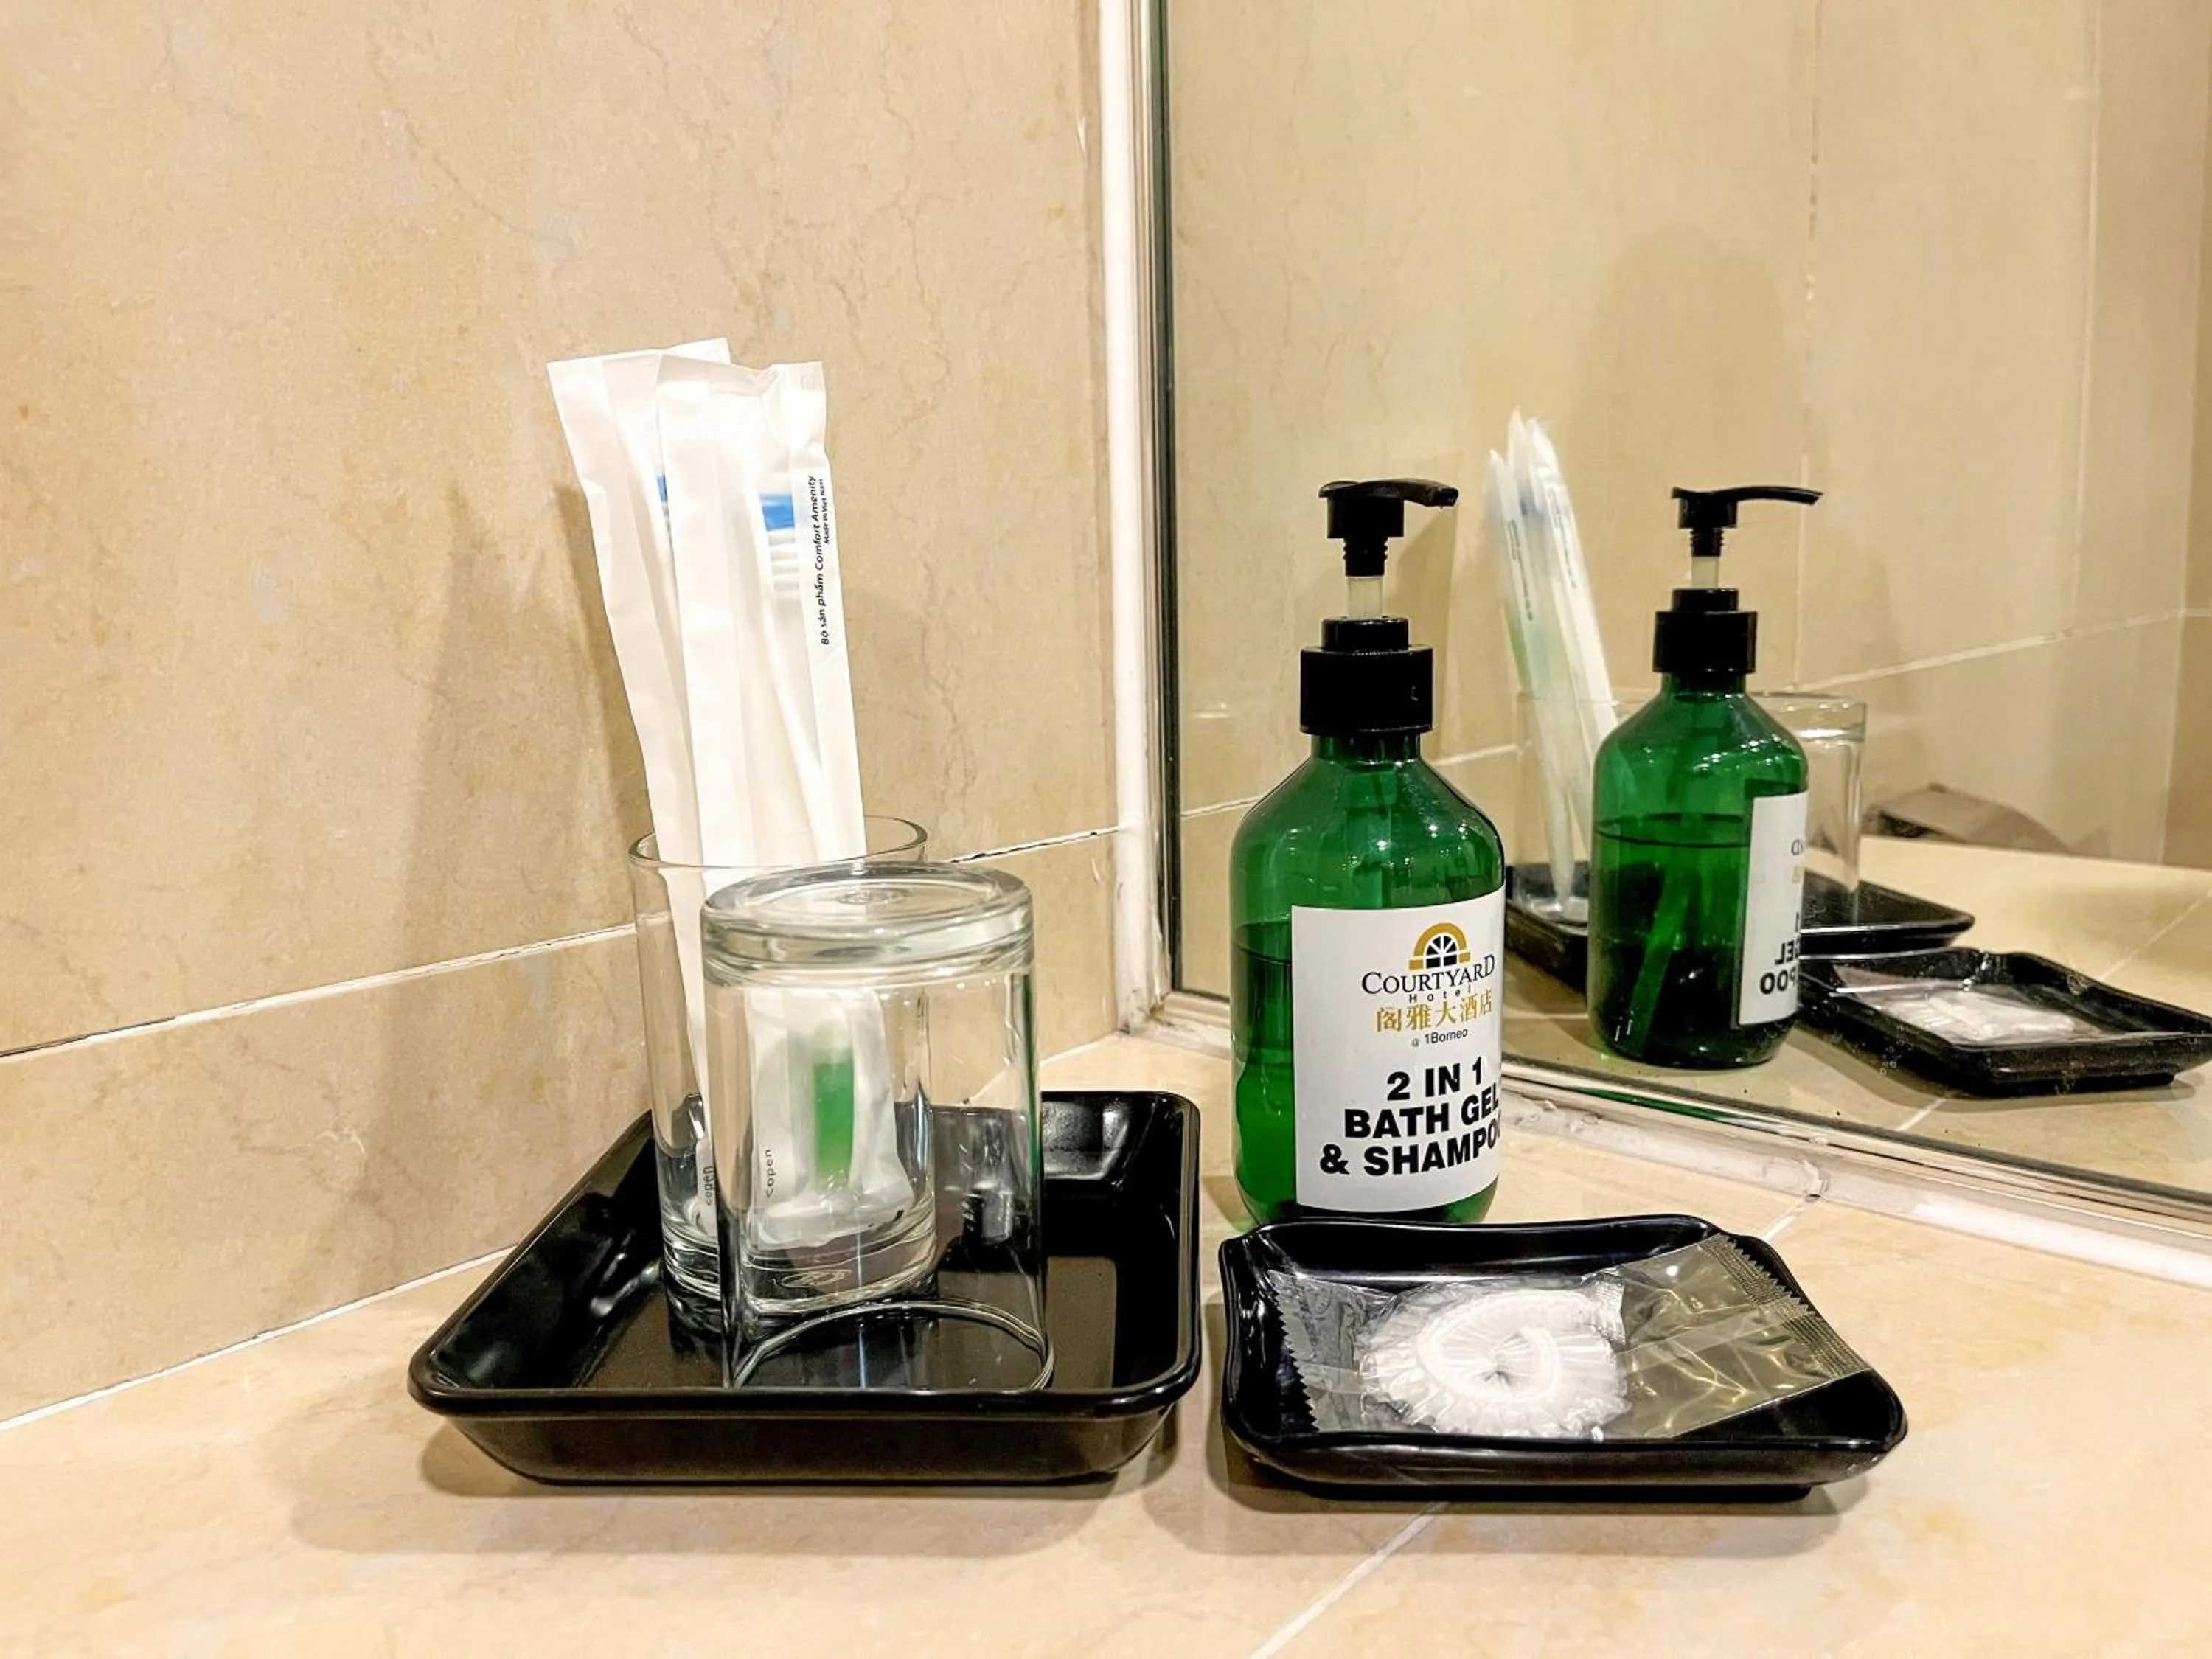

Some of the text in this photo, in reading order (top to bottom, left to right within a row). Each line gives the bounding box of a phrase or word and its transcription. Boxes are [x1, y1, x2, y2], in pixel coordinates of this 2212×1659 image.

[808, 475, 819, 523] Amenity
[813, 524, 824, 571] Comfort
[1361, 954, 1495, 995] COURTYARD
[1409, 984, 1472, 1004] Hotel
[1376, 988, 1492, 1033] 阁雅大酒店
[1424, 1029, 1468, 1045] 1Borneo
[1387, 1056, 1482, 1101] 2 IN 1
[1344, 1082, 1499, 1138] BATH GEL
[1319, 1144, 1350, 1175] &
